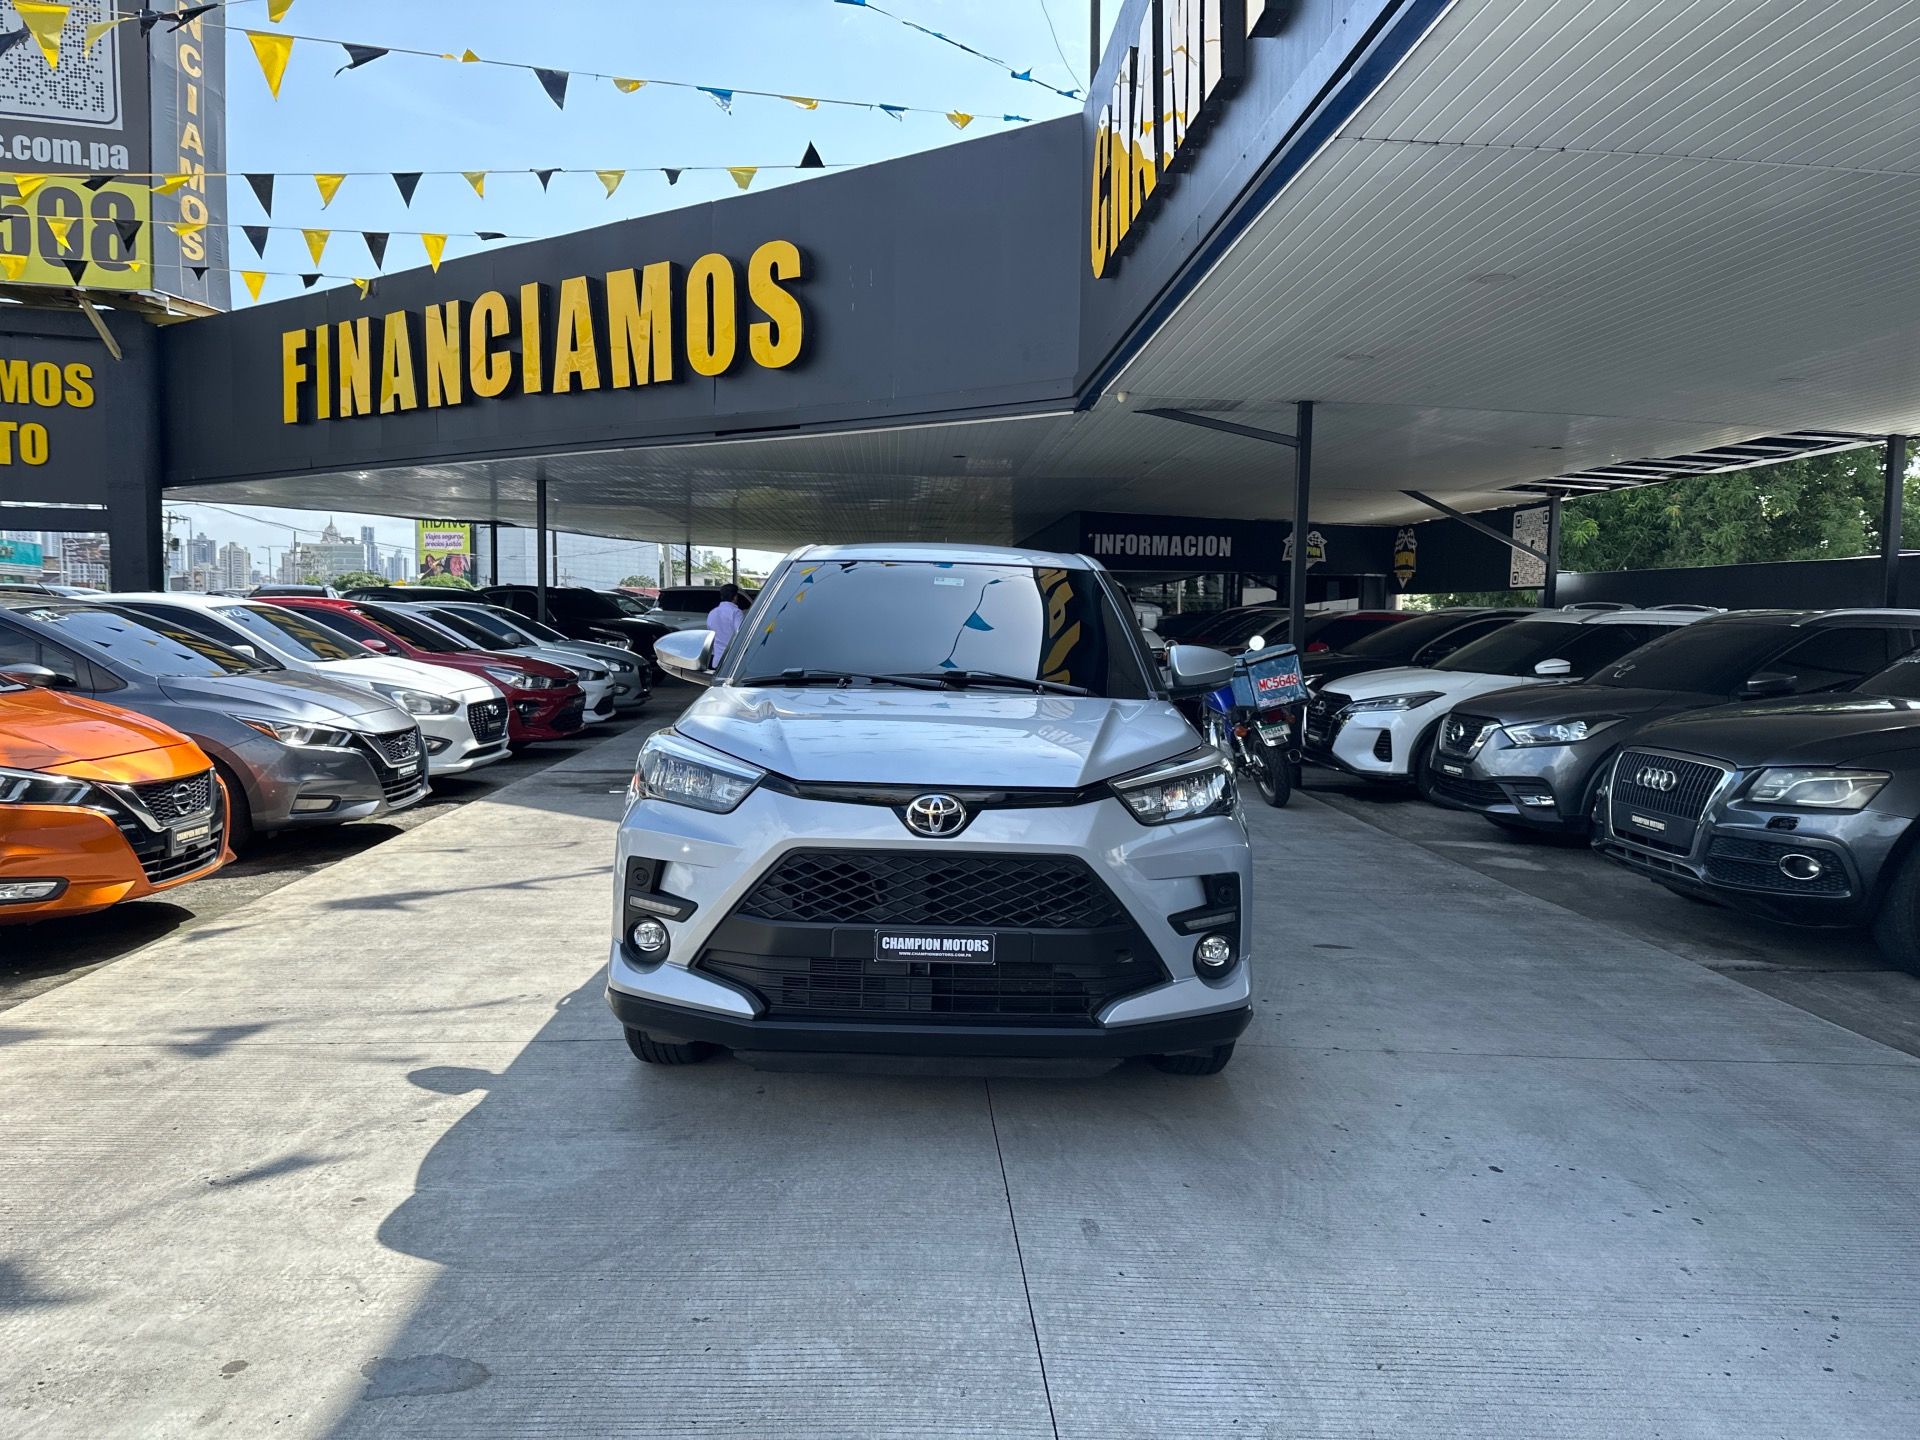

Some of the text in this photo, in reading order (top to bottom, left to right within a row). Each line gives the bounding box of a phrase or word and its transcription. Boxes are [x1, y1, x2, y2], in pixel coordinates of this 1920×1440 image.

[0, 133, 129, 170] .com.pa
[282, 240, 804, 424] FINANCIAMOS
[1094, 534, 1232, 557] INFORMACION
[1259, 674, 1298, 690] MC5648
[882, 937, 989, 951] CHAMPION MOTORS
